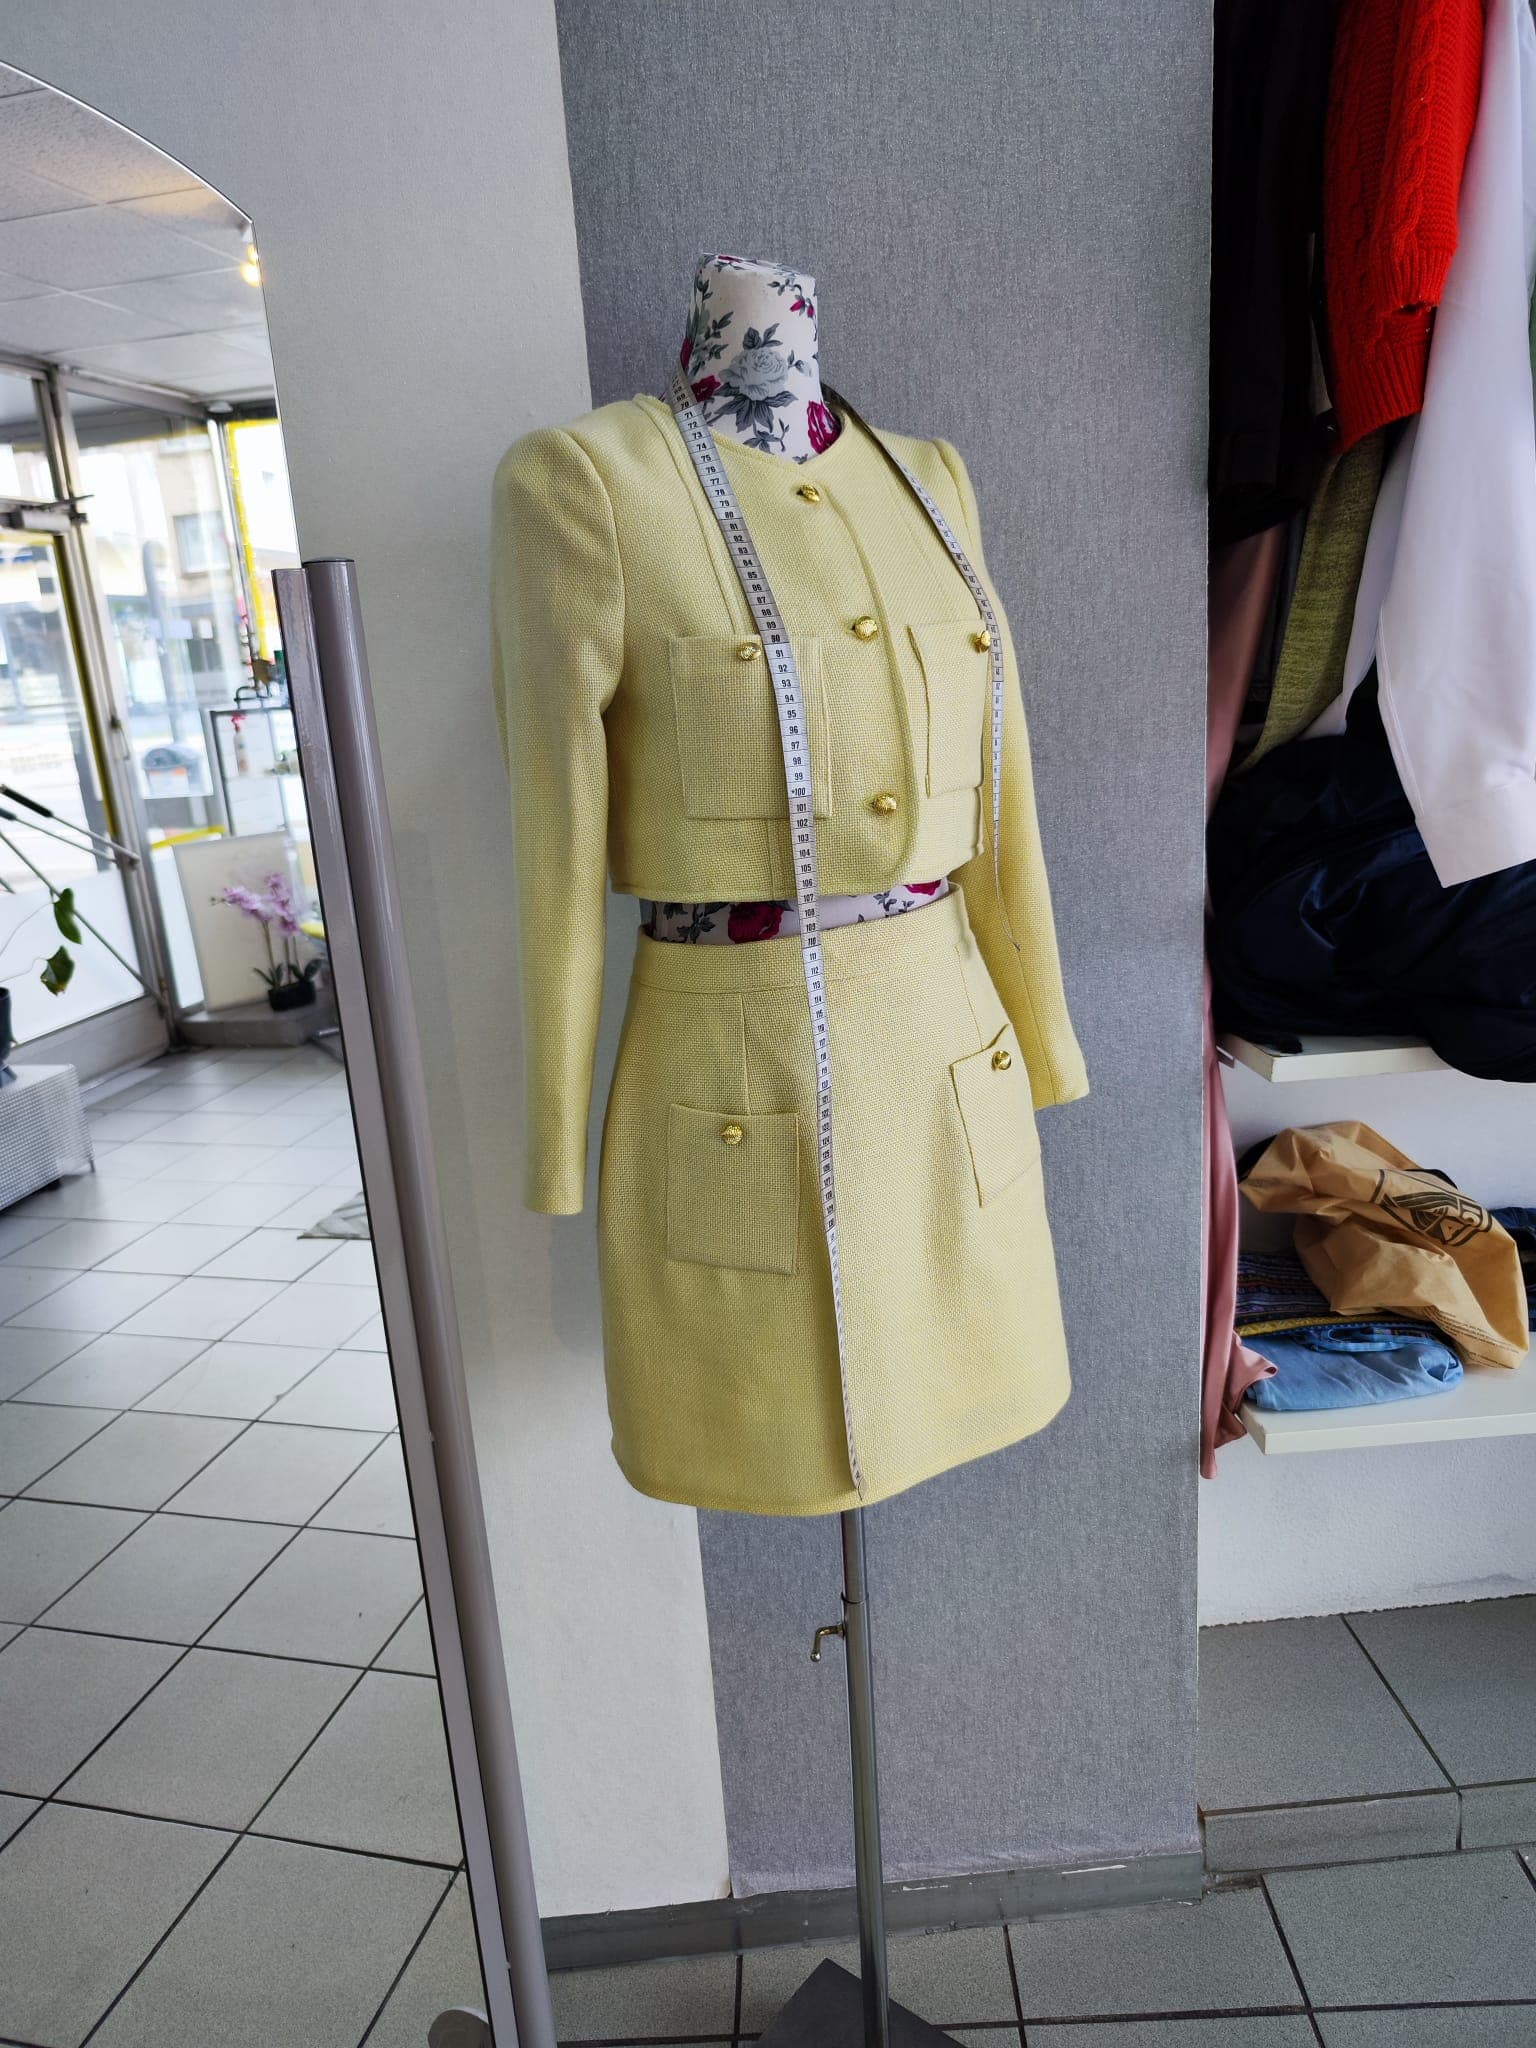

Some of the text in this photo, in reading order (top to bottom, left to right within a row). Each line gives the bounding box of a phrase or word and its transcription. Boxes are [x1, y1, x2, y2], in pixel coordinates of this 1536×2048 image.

[693, 431, 702, 439] 73
[697, 442, 707, 450] 74
[701, 454, 711, 462] 75
[706, 465, 716, 474] 76
[710, 477, 720, 485] 77
[715, 488, 725, 496] 78
[720, 499, 730, 508] 79
[725, 511, 734, 519] 80
[734, 534, 743, 542] 82
[748, 571, 757, 579] 85
[752, 583, 762, 591] 86
[757, 596, 766, 604] 87
[762, 608, 771, 616] 88
[771, 634, 780, 642] 90
[776, 649, 784, 658] 91
[779, 664, 787, 672] 92
[782, 679, 791, 688] 93
[785, 694, 794, 702] 94
[787, 709, 796, 718] 95
[789, 726, 798, 734] 96
[791, 741, 800, 750] 97
[793, 757, 802, 765] 98
[794, 772, 803, 780] 99
[795, 787, 806, 796] 100
[797, 803, 806, 812] 101
[797, 818, 808, 828] 102
[798, 833, 809, 843] 103
[799, 849, 810, 857] 104
[801, 864, 811, 872] 105
[802, 878, 813, 887] 106
[803, 893, 814, 902] 107
